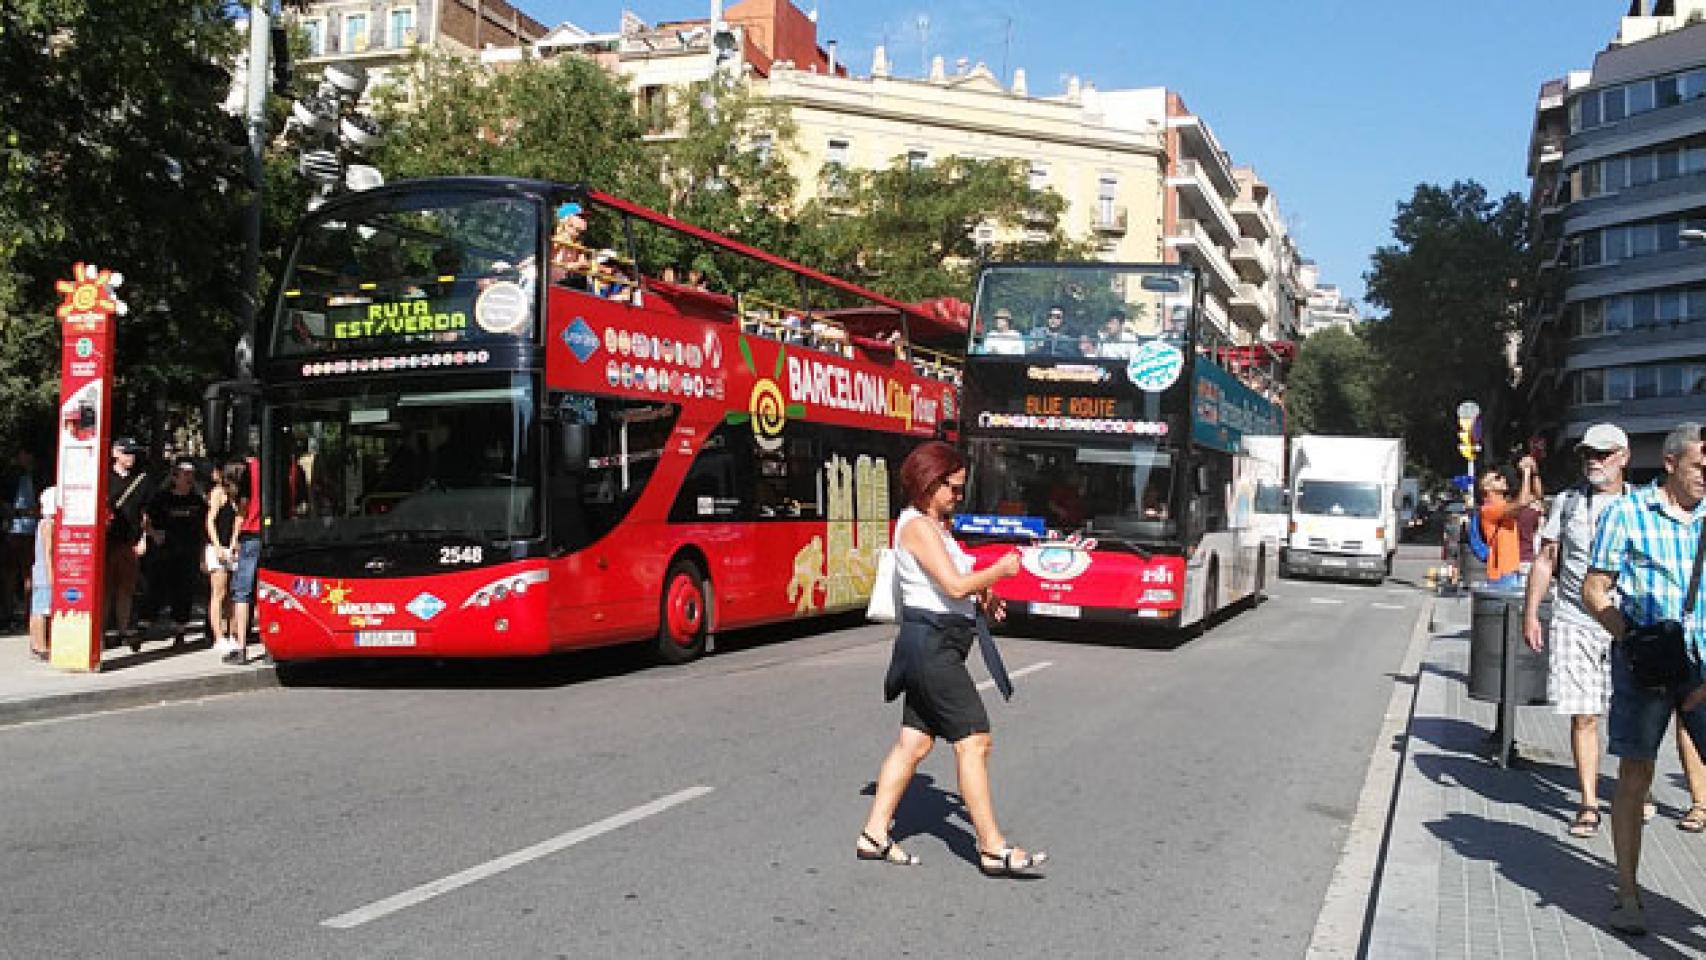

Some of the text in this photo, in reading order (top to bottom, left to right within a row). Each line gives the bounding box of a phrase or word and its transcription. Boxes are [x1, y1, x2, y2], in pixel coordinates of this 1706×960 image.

[368, 300, 428, 319] RUTA
[335, 311, 466, 339] EST/VERDA
[788, 356, 888, 415] BARCELONA
[1025, 394, 1117, 416] BLUE ROUTE
